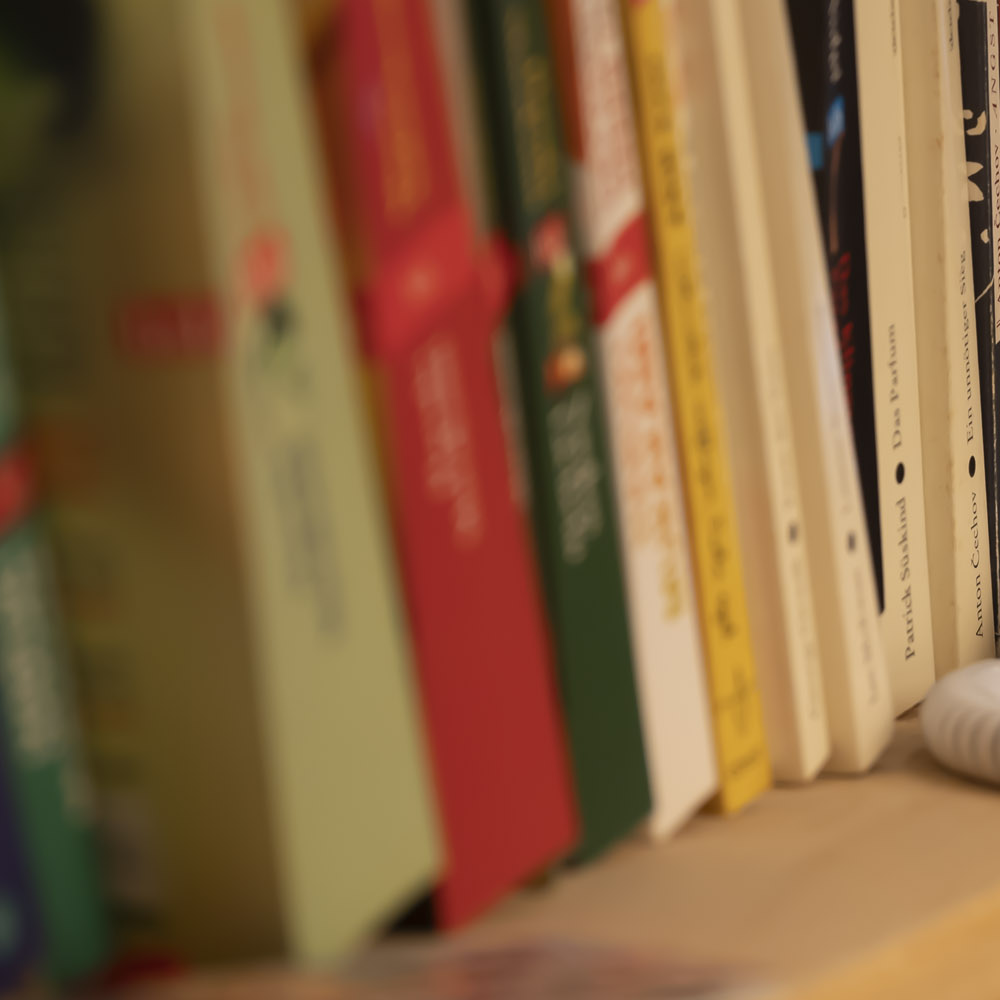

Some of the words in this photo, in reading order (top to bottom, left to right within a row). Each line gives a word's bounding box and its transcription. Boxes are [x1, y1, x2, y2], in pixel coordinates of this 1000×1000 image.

[988, 10, 998, 120] ANGST
[959, 250, 967, 296] Sieg
[887, 323, 899, 404] Parfum
[961, 302, 972, 401] unnötiger
[892, 407, 903, 451] Das
[966, 406, 974, 445] Ein
[895, 496, 911, 582] Süskind
[970, 491, 980, 569] Čechov
[901, 585, 916, 662] Patrick
[975, 574, 984, 638] Anton
